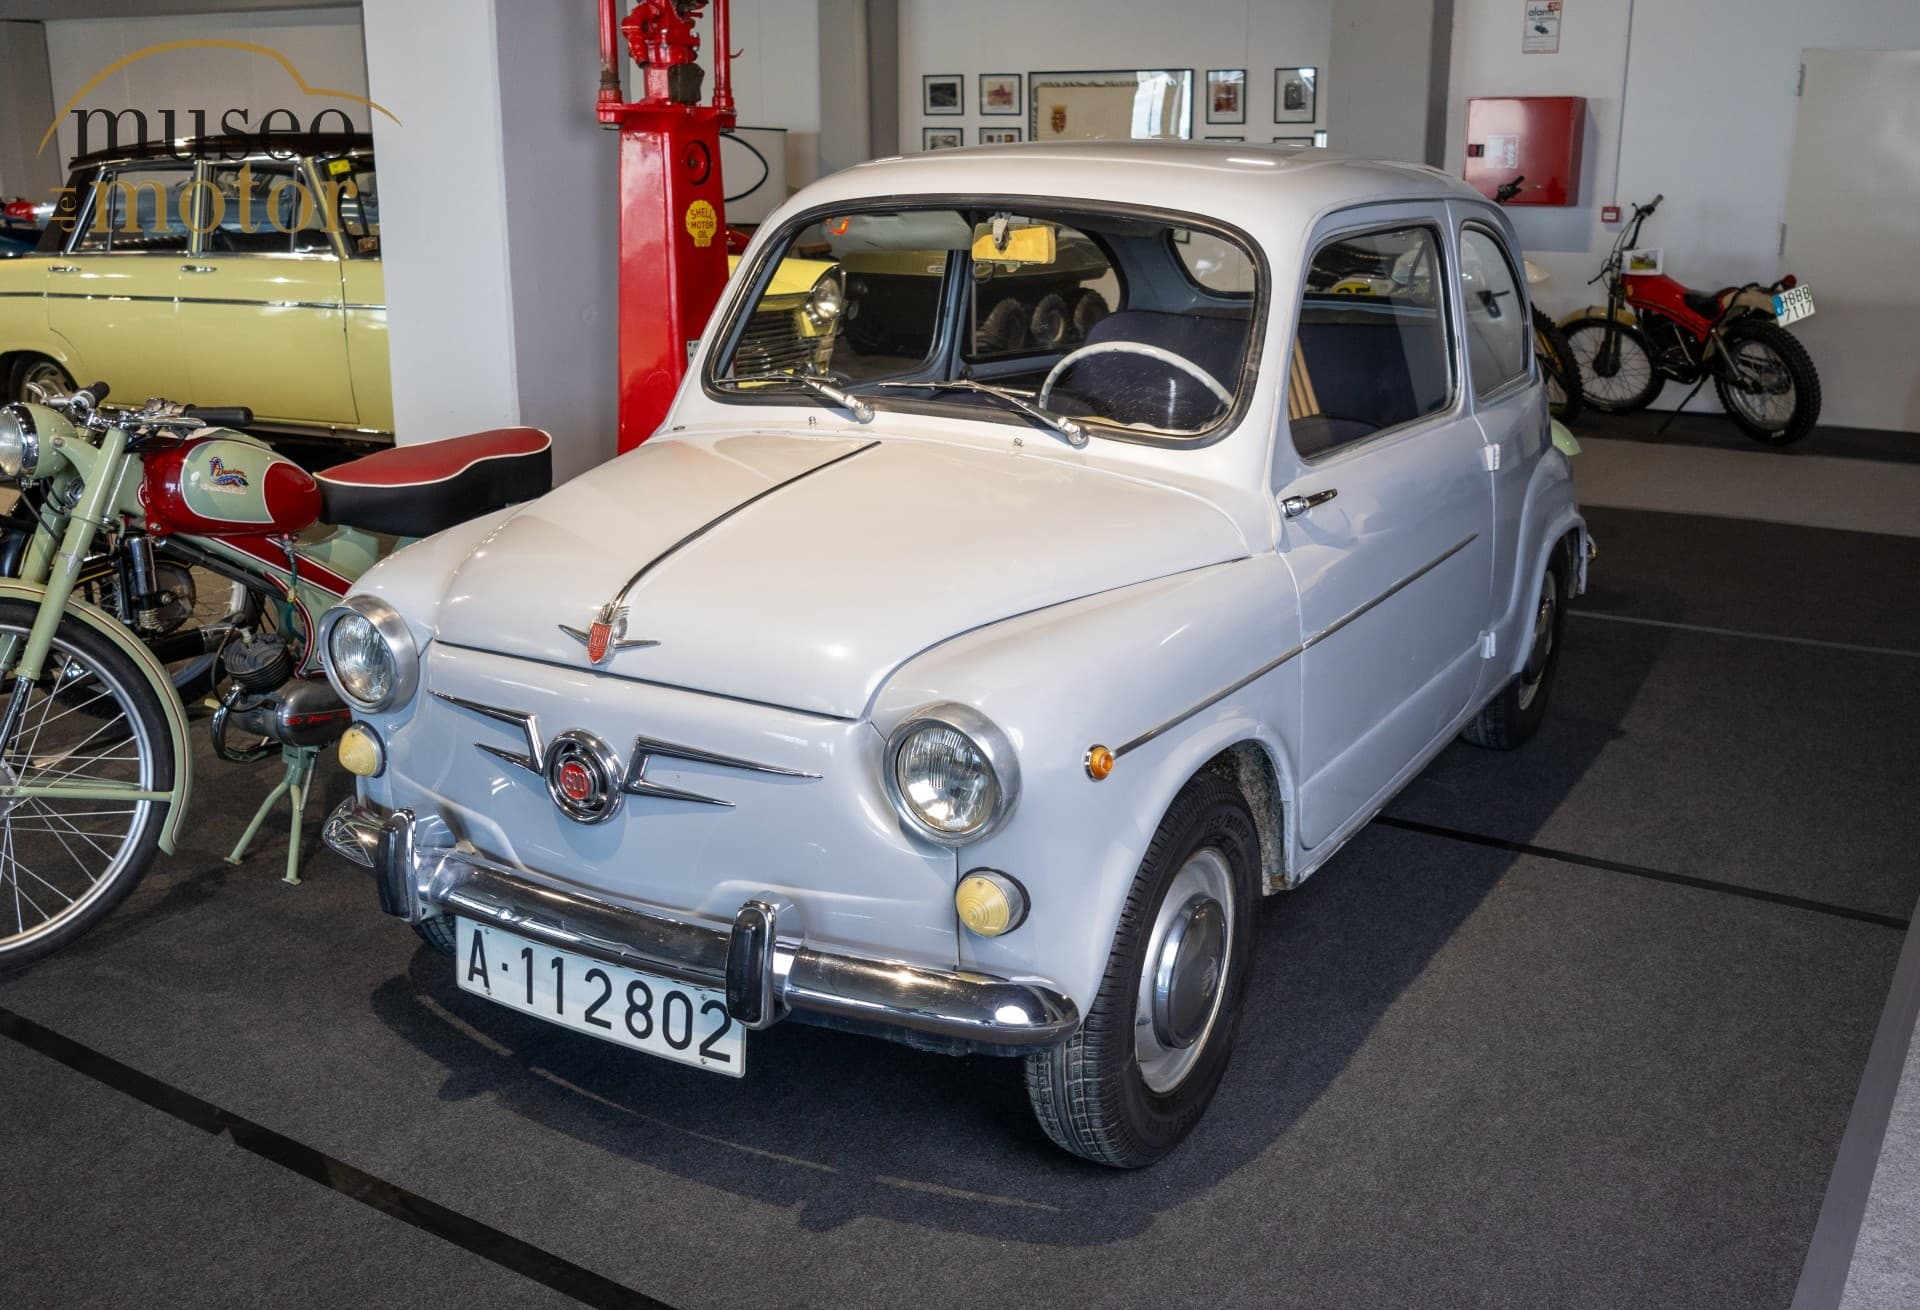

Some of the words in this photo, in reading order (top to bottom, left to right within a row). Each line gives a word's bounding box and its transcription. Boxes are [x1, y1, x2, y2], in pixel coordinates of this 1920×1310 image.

[690, 208, 713, 219] SHELL
[690, 220, 714, 230] MOTOR
[697, 230, 708, 239] OIL
[1784, 299, 1812, 321] 7117
